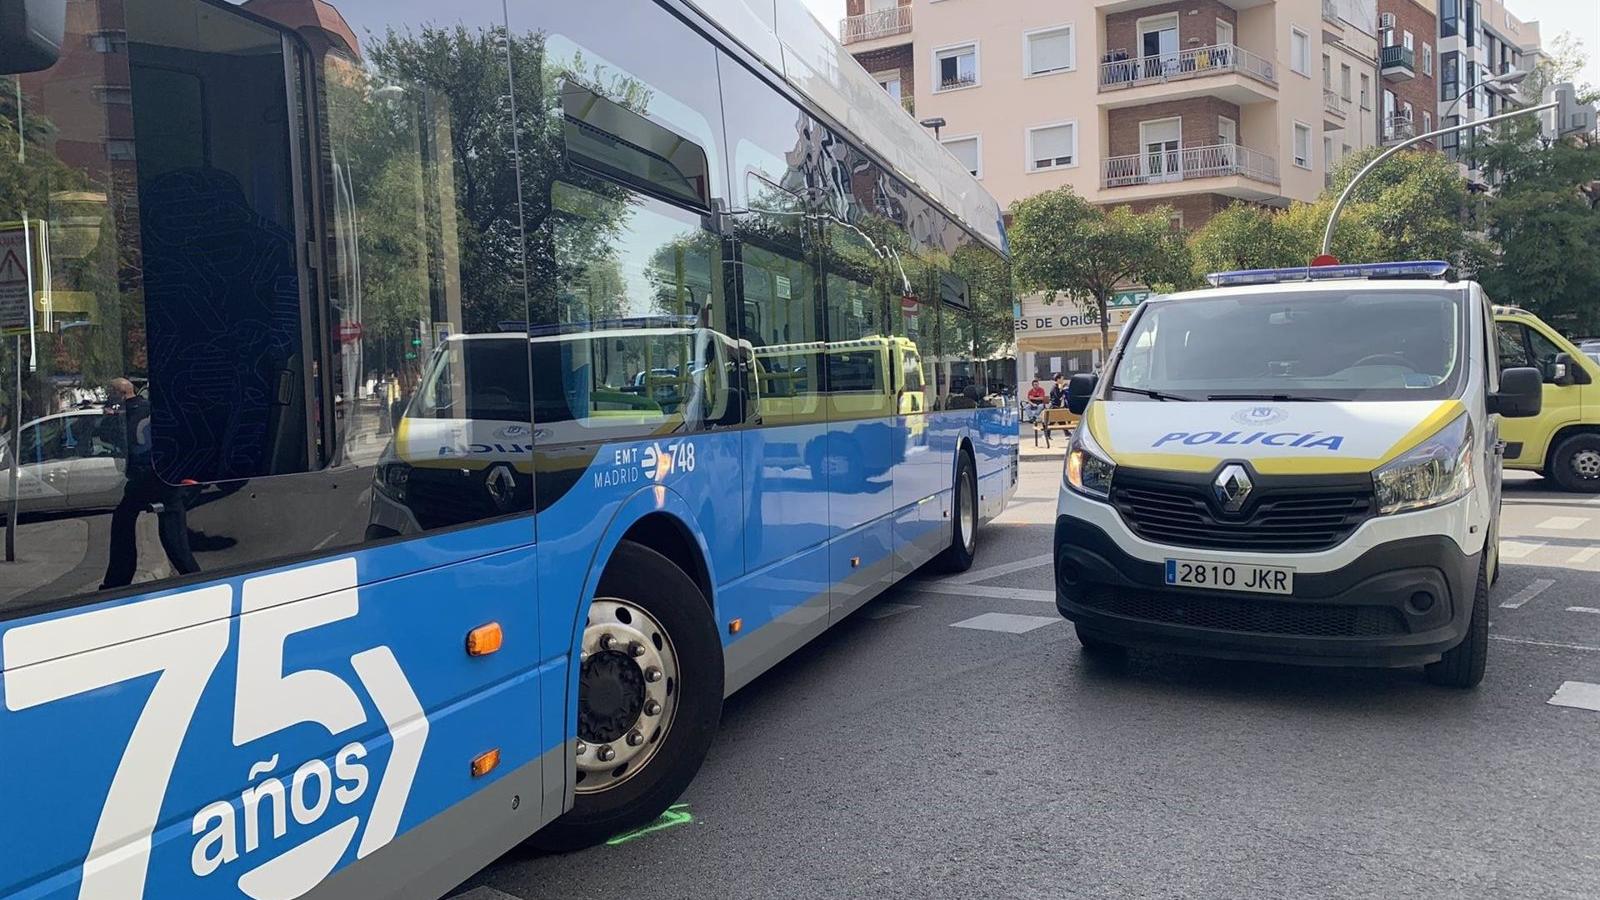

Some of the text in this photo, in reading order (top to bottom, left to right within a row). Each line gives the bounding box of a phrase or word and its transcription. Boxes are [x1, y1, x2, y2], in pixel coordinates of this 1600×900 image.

[1035, 317, 1053, 329] DE
[1151, 430, 1345, 451] POLICÍA
[615, 442, 695, 474] EMT 748
[594, 466, 639, 489] MADRID
[1180, 563, 1287, 591] 2810 JKR
[3, 557, 367, 900] 75
[190, 740, 369, 877] años
